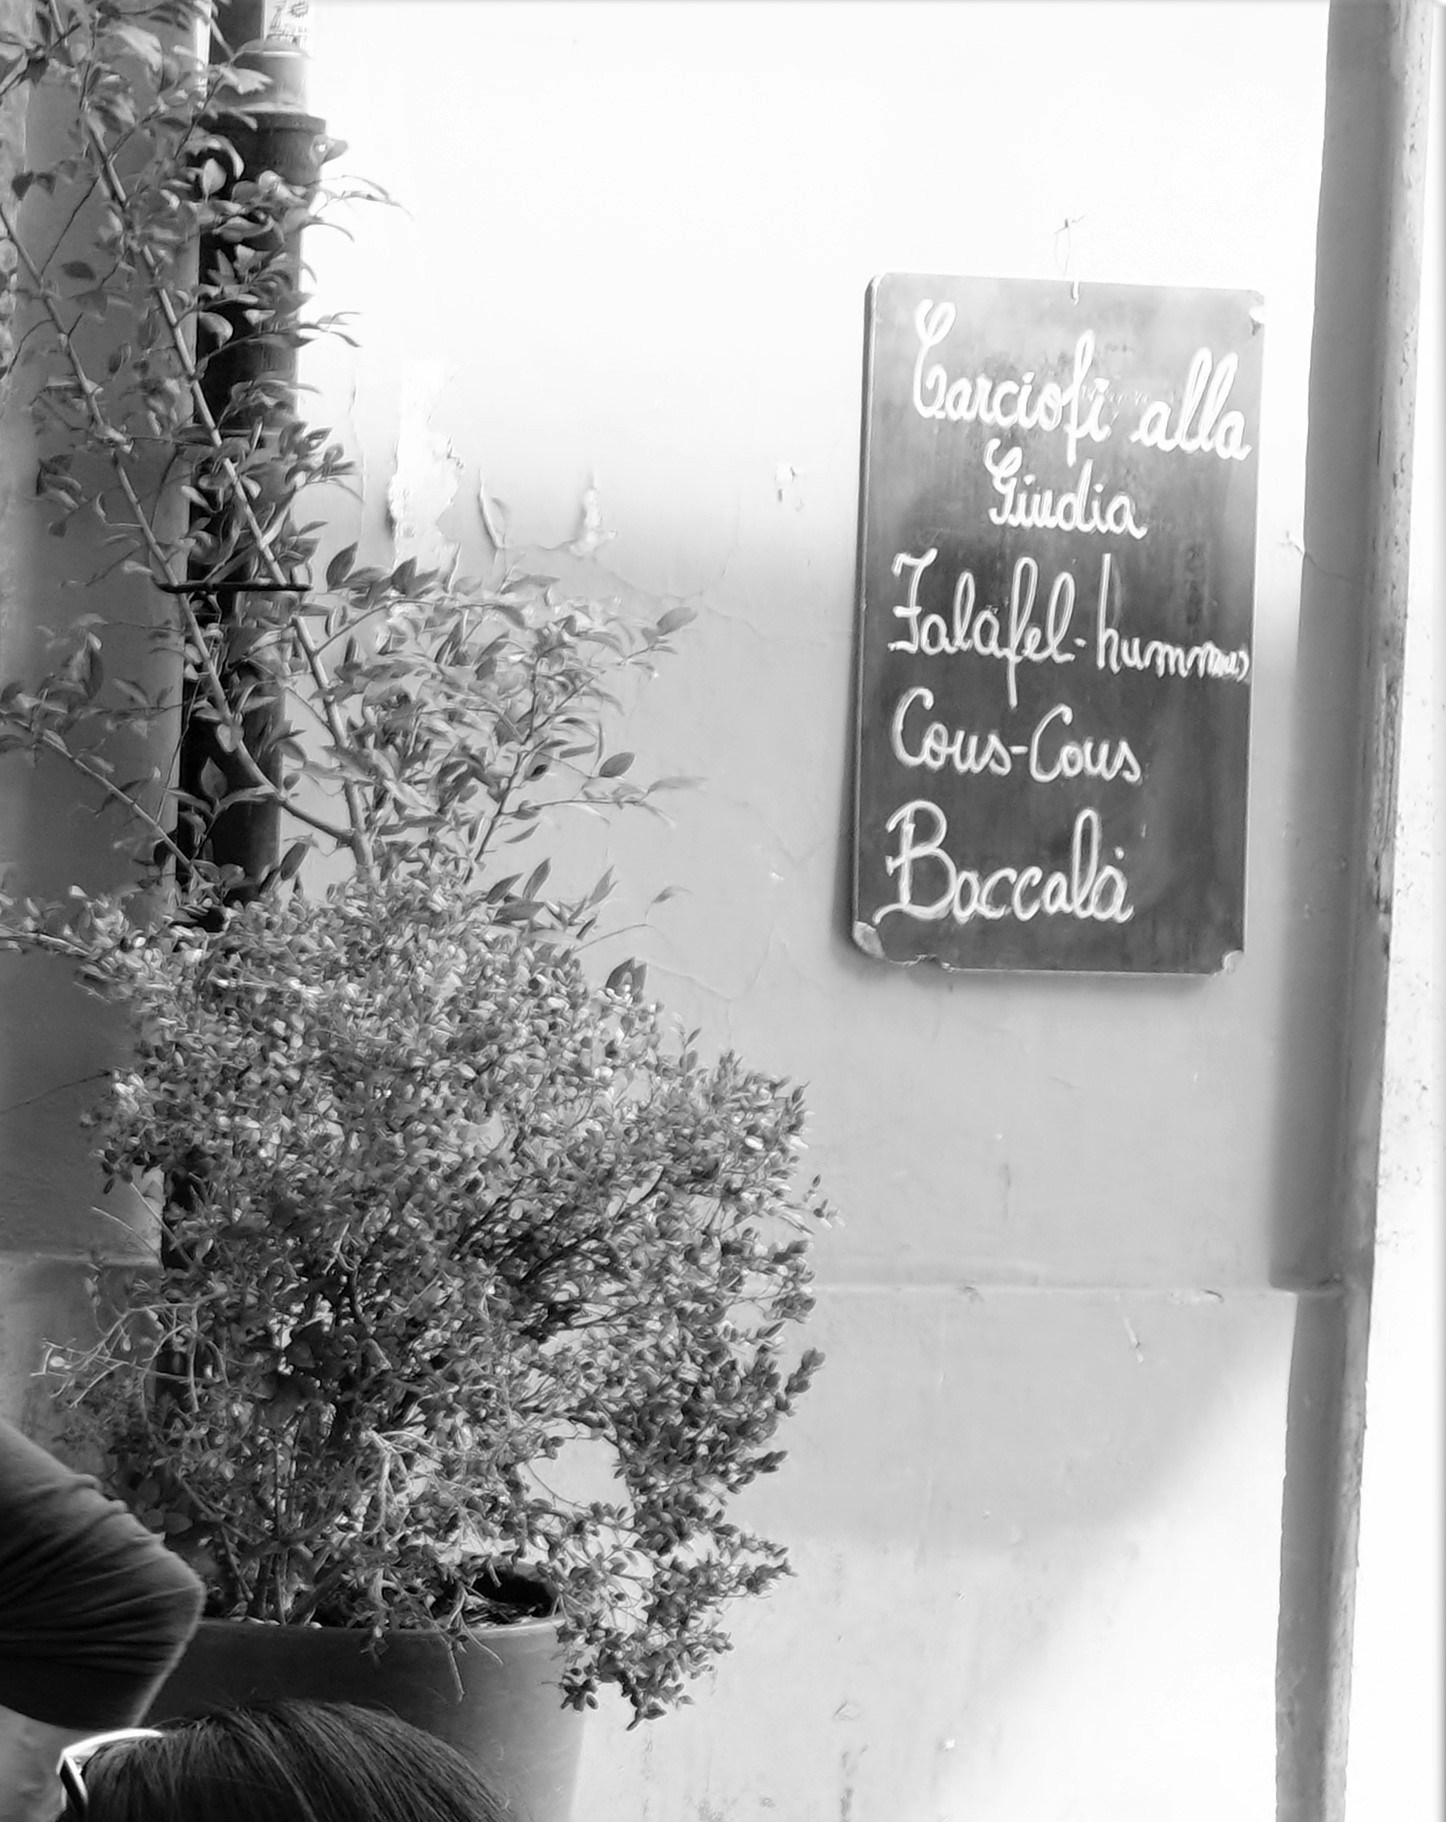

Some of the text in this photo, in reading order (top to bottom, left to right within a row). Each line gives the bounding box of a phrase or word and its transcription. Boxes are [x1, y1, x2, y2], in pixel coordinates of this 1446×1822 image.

[913, 298, 1252, 467] Carciofi alla
[984, 437, 1148, 540] Giudia
